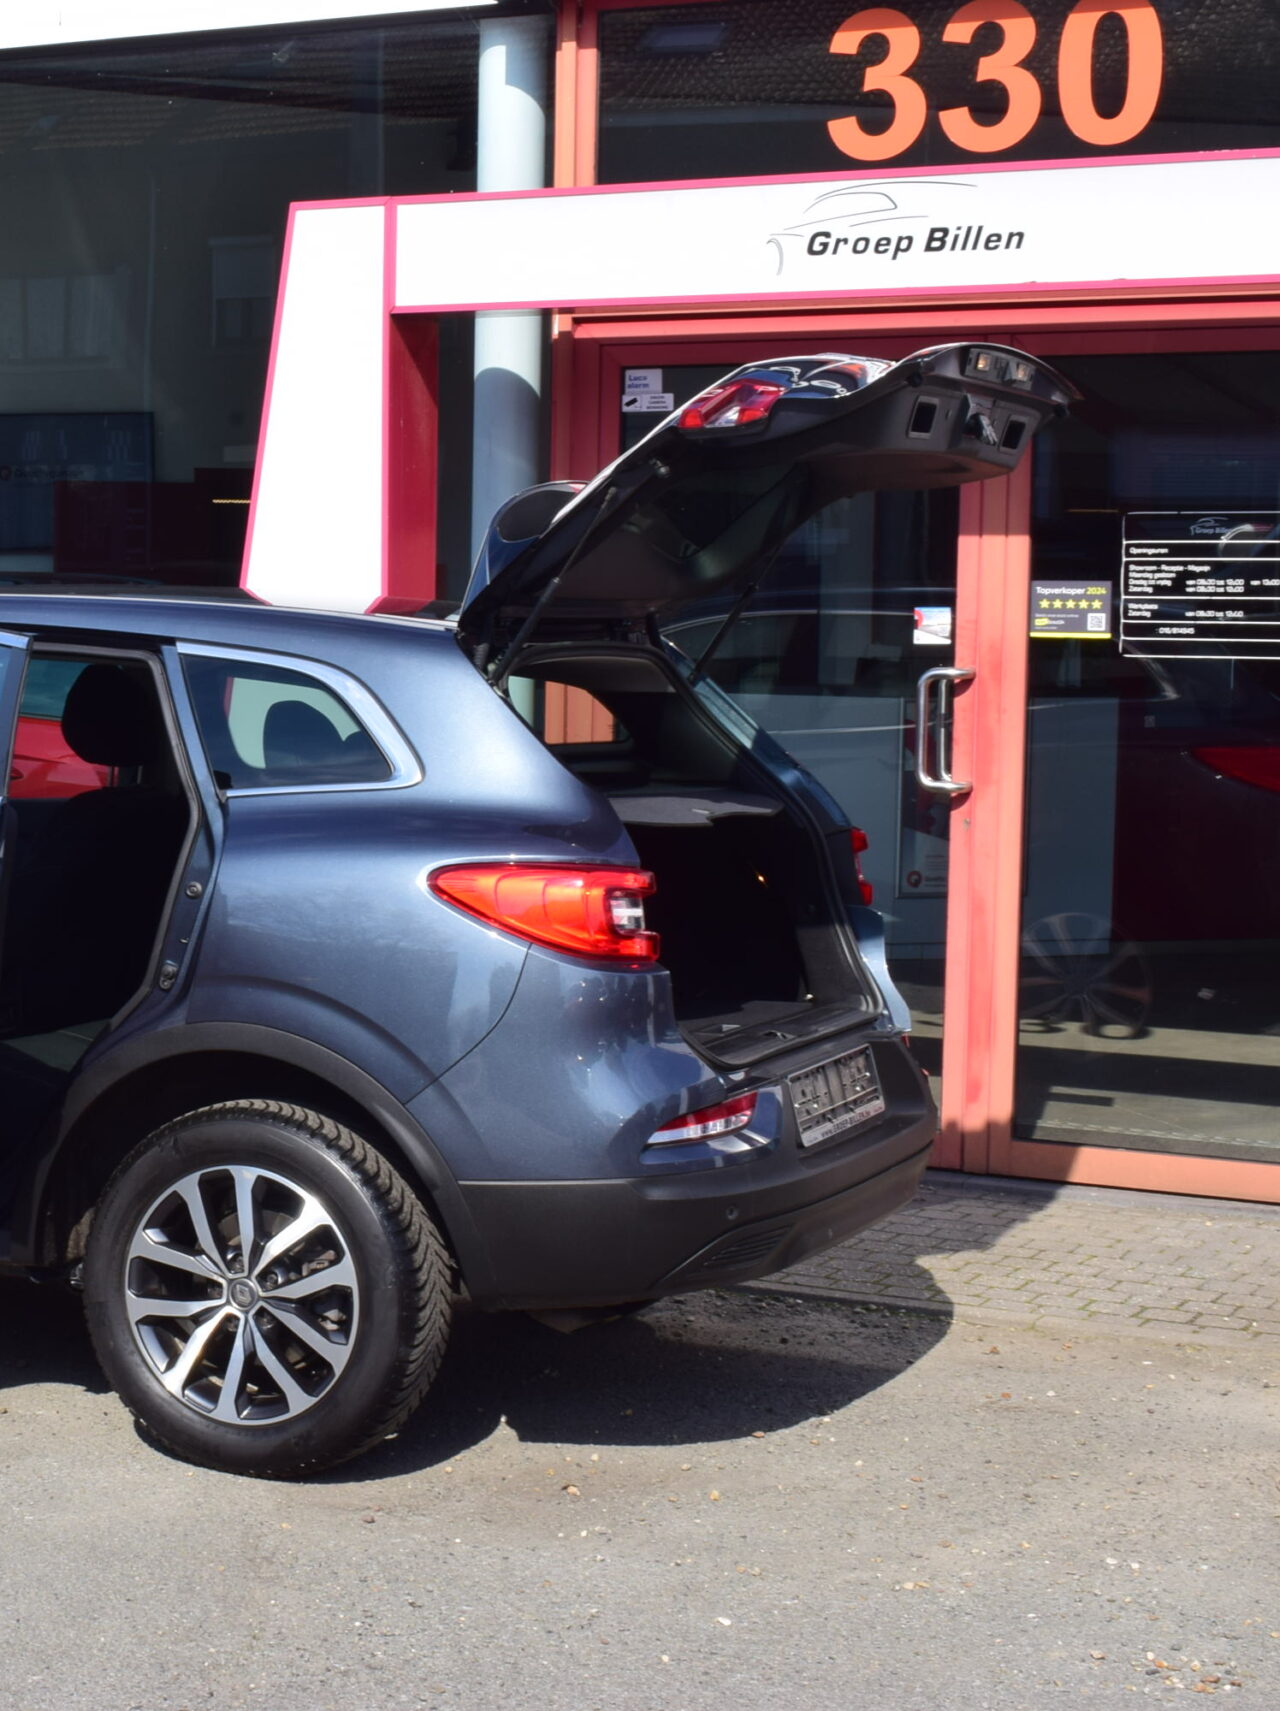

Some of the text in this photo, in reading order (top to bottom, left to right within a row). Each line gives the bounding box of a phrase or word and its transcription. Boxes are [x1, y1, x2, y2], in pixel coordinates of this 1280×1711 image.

[827, 0, 1164, 162] 330
[806, 225, 1025, 261] Groep Billen
[1035, 586, 1085, 595] Topverkoper
